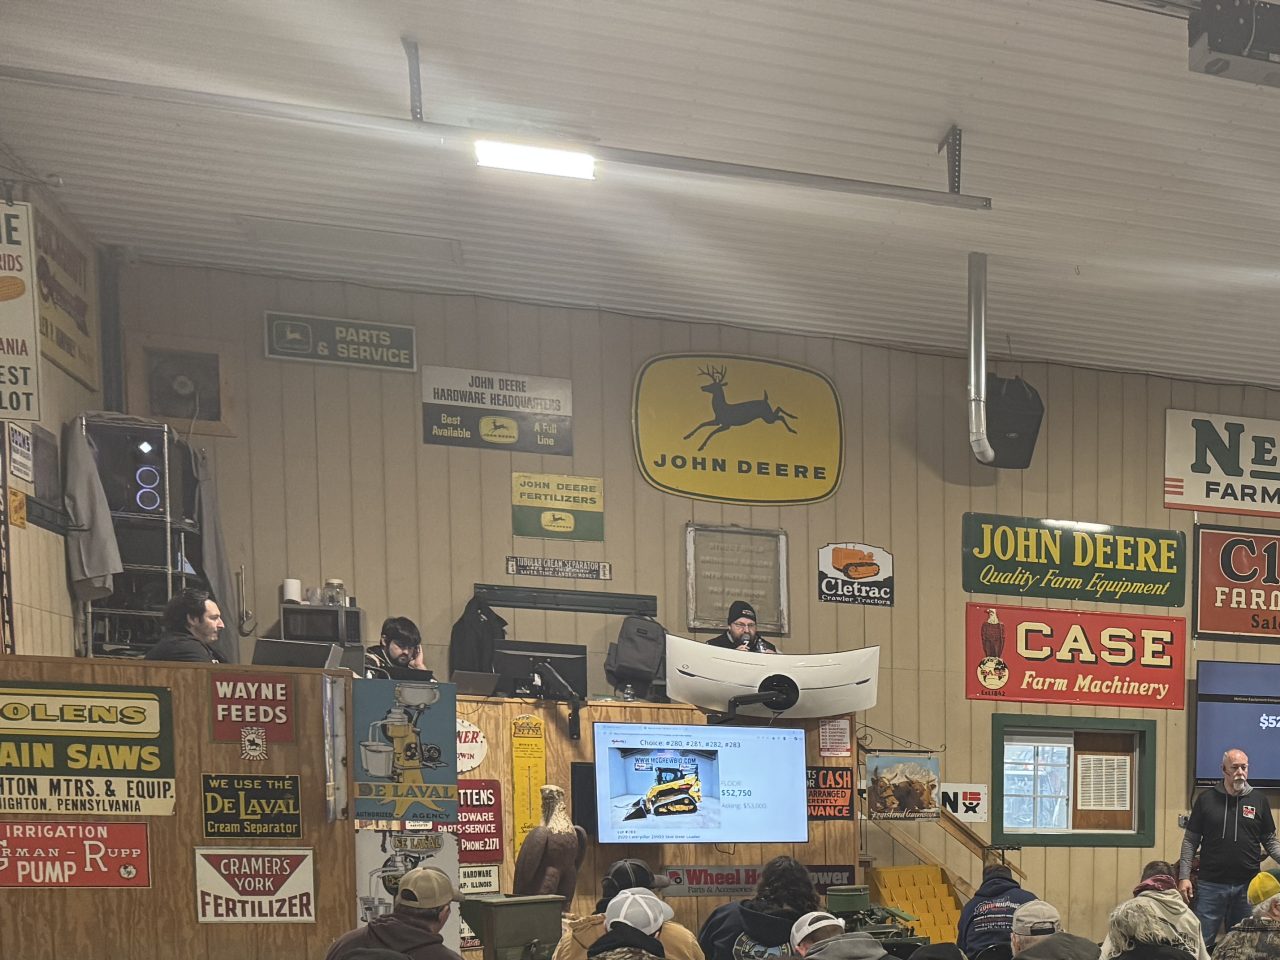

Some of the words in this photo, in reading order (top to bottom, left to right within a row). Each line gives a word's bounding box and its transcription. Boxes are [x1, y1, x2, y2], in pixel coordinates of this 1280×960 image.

[335, 326, 391, 345] PARTS
[317, 343, 329, 356] &
[336, 344, 410, 364] SERVICE
[468, 375, 494, 391] JOHN
[498, 377, 527, 393] DEERE
[432, 387, 486, 405] HARDWARE
[490, 391, 562, 412] HEADQUARTERS
[441, 413, 461, 426] Best
[432, 424, 471, 439] Available
[653, 453, 727, 473] JOHN
[738, 460, 827, 480] DEERE
[519, 480, 550, 490] JOHN
[556, 483, 597, 493] DEERE
[519, 492, 597, 505] FERTILIZERS
[973, 523, 1062, 564] JOHN
[1073, 532, 1178, 574] DEERE
[565, 560, 599, 571] SEPARATOR
[821, 578, 890, 599] Cletrac
[979, 564, 1040, 592] Quality
[1040, 569, 1083, 589] Farm
[1085, 572, 1171, 599] Equipment
[856, 597, 891, 605] Tractors
[1016, 621, 1173, 668] CASE
[215, 681, 287, 701] WAYNE
[1020, 670, 1069, 691] Farm
[1073, 674, 1169, 700] Machinery
[0, 702, 147, 725] OLENS
[217, 704, 288, 724] FEEDS
[639, 739, 665, 747] Choice:
[666, 740, 684, 748] #280,
[725, 741, 741, 749] #283
[67, 743, 161, 771] SAWS
[49, 778, 100, 798] MTRS.
[104, 780, 116, 797] &
[127, 780, 174, 799] EQUIP.
[208, 779, 229, 789] WE
[234, 780, 262, 789] USE
[266, 780, 293, 790] THE
[819, 770, 852, 789] CASH
[358, 784, 386, 797] DE
[399, 784, 454, 799] LAVAL
[721, 788, 752, 798] $52,750
[57, 798, 141, 812] PENNSYLVANIA
[6, 825, 108, 839] IRRIGATION
[207, 821, 240, 833] Cream
[243, 821, 298, 835] Separator
[461, 839, 485, 851] PHONE
[17, 860, 77, 883] PUMP
[220, 857, 291, 876] CRAMER'S
[462, 869, 492, 879] HARDWARE
[234, 877, 275, 891] YORK
[685, 869, 741, 885] Wheel
[200, 890, 313, 918] FERTILIZER
